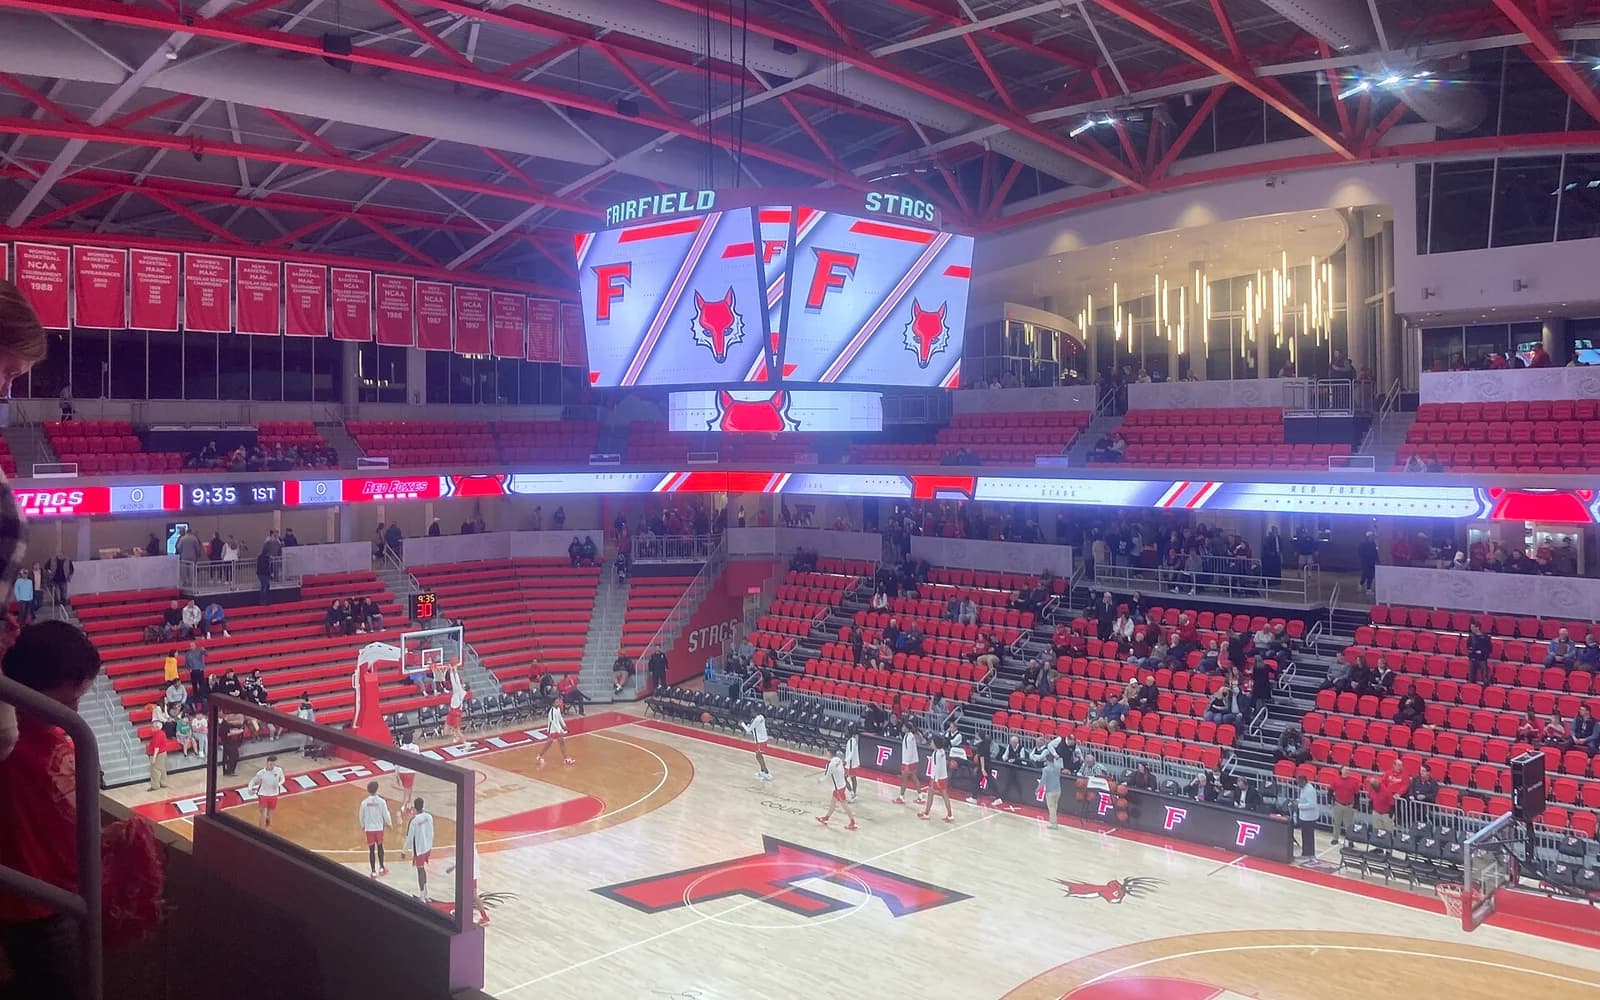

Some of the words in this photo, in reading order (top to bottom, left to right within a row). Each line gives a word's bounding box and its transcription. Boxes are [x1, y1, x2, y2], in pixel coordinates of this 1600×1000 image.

[606, 190, 715, 227] FAIRFIELD
[865, 192, 934, 221] STAGS
[27, 261, 57, 270] NCAA
[811, 247, 859, 310] F
[31, 282, 53, 292] 1988
[384, 290, 406, 298] NCAA
[590, 261, 632, 321] F
[130, 488, 144, 502] 0
[316, 482, 327, 496] 0
[362, 481, 388, 494] RED
[388, 480, 428, 492] FOXES
[17, 491, 84, 507] TAGS
[192, 487, 236, 504] 9:35
[251, 488, 276, 501] 1ST
[418, 593, 436, 603] 9:35
[417, 602, 432, 618] 30
[688, 618, 738, 653] STAGS
[876, 744, 893, 766] F
[760, 800, 811, 816] COURT
[1164, 806, 1187, 830] F
[1236, 820, 1261, 846] F
